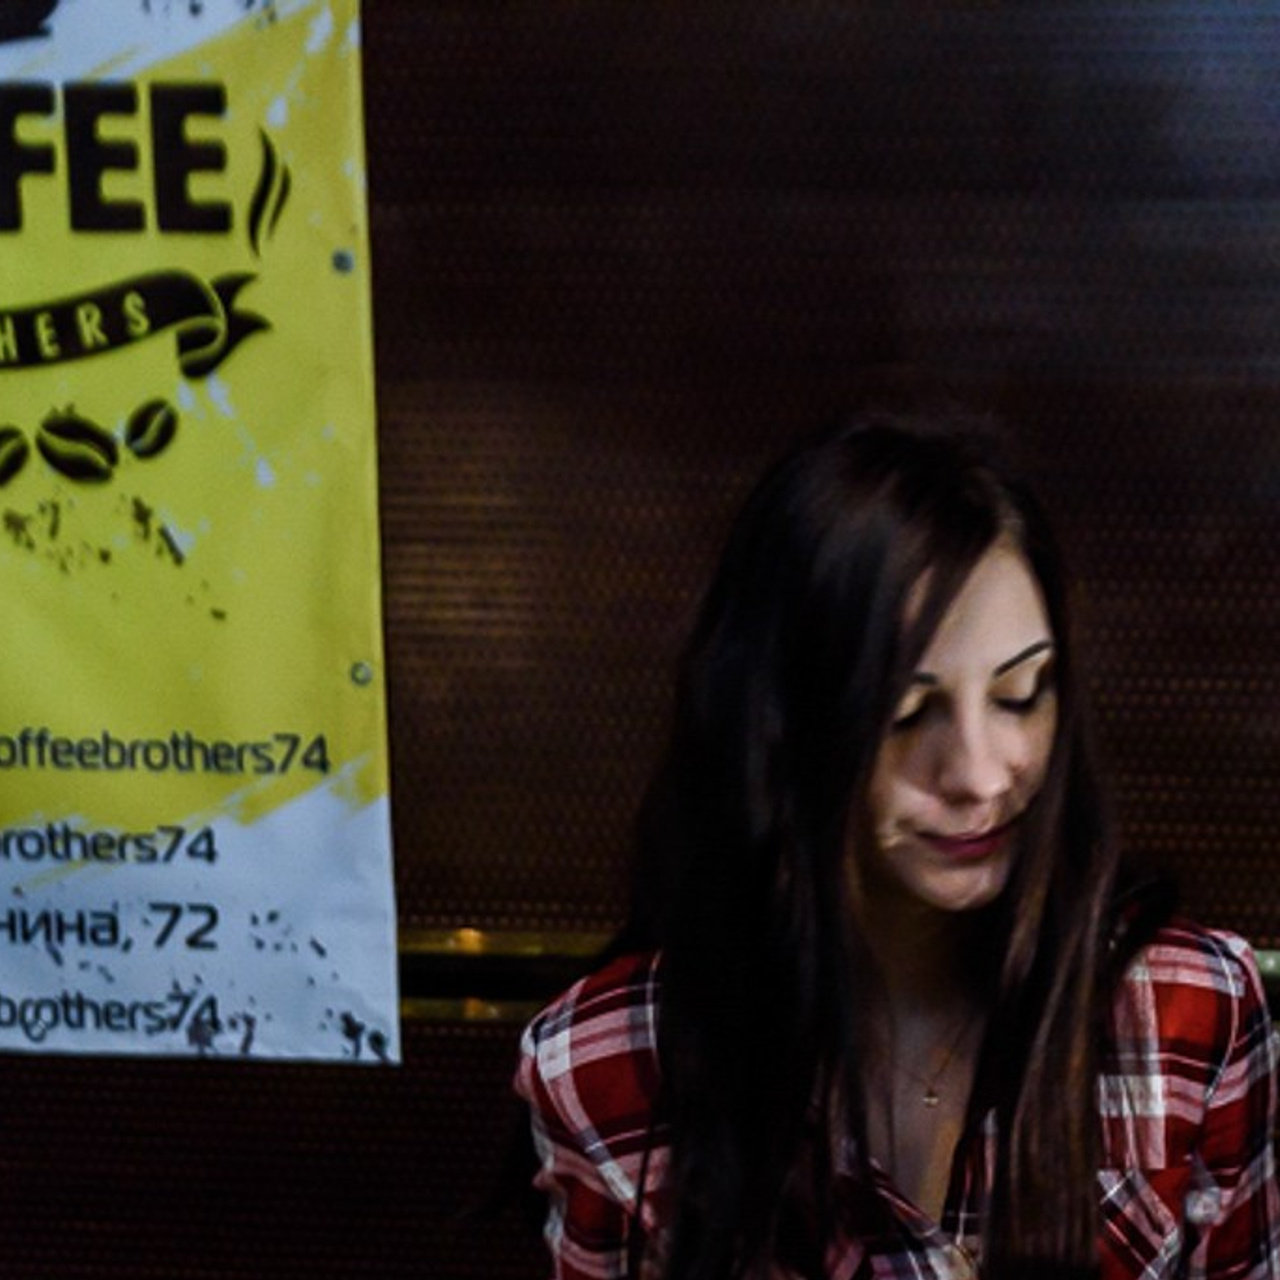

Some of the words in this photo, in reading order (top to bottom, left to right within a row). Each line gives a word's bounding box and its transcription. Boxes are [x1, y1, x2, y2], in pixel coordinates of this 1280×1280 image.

[0, 82, 232, 233] FEE
[0, 290, 151, 362] HERS
[148, 902, 219, 950] 72
